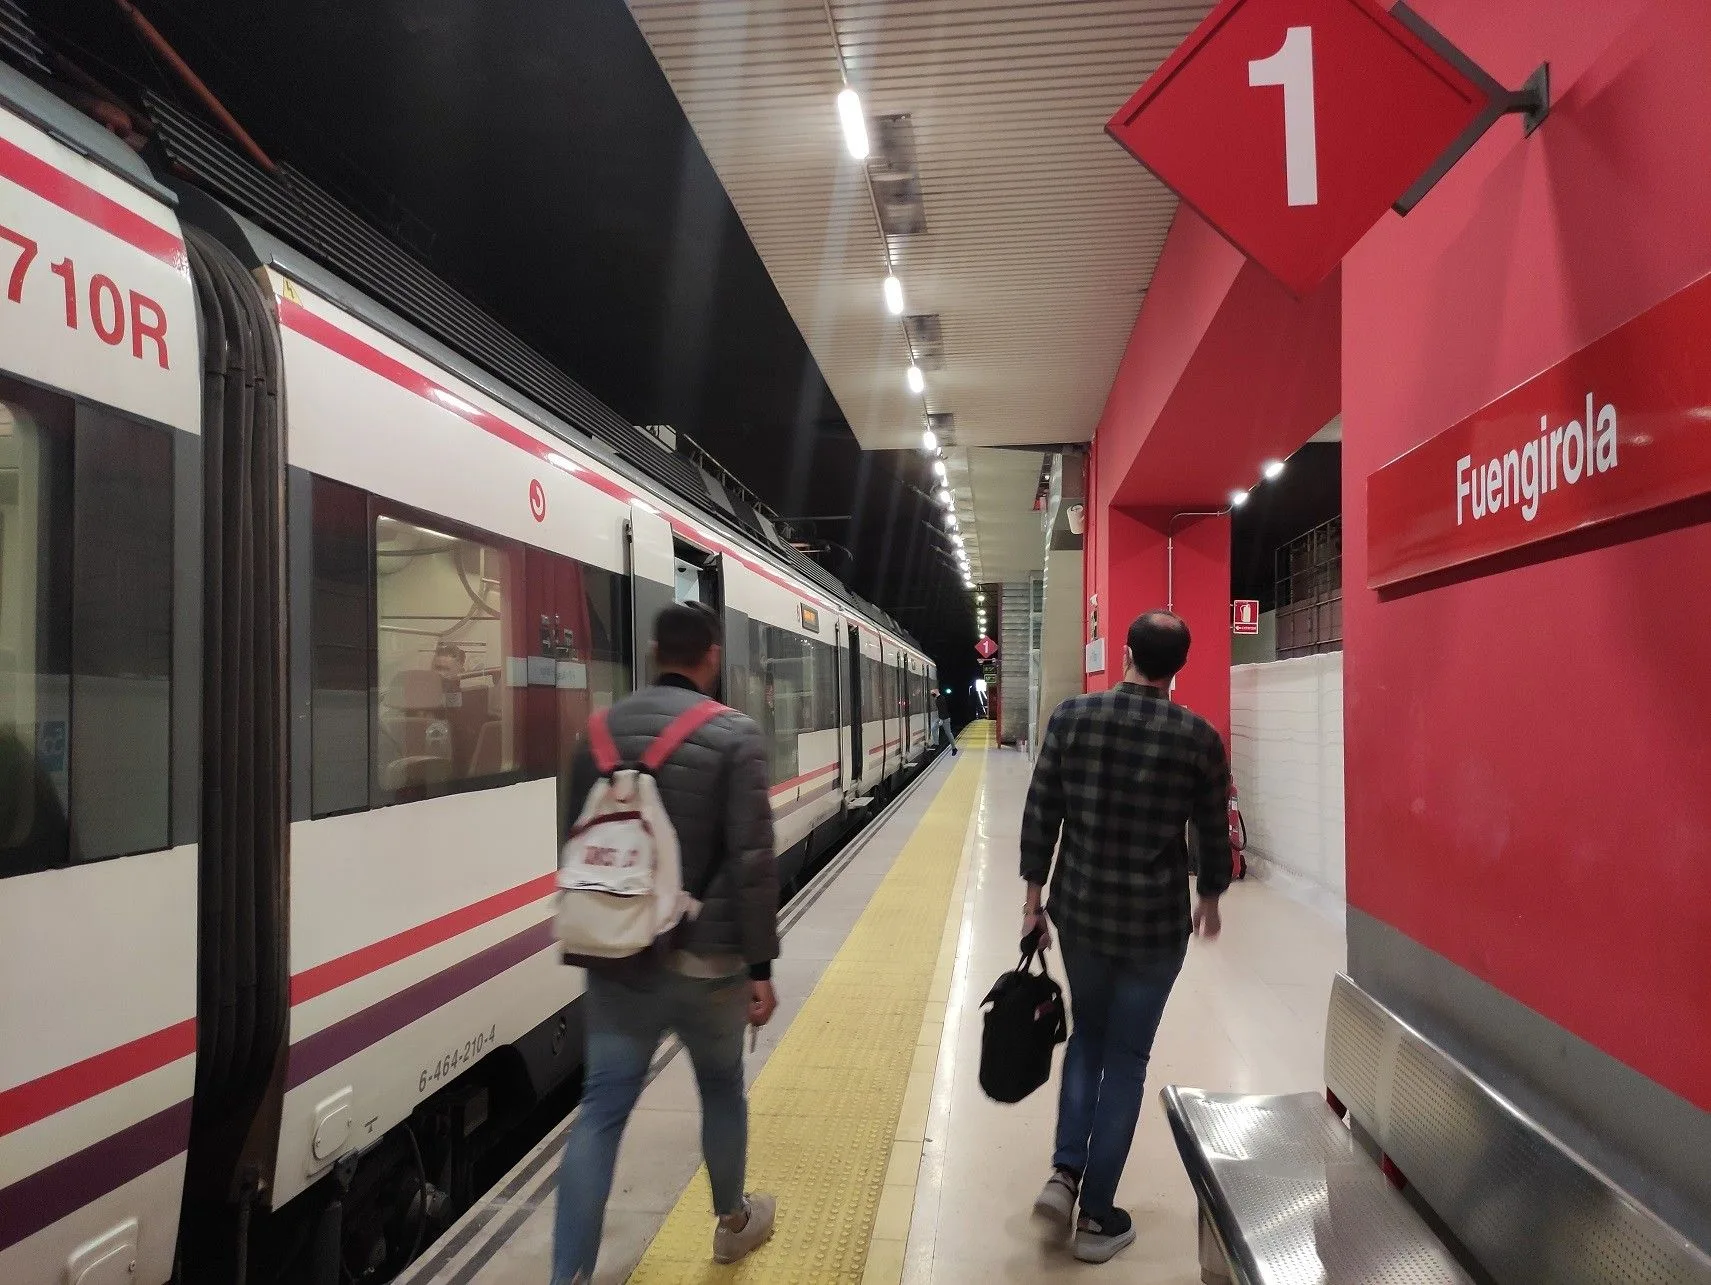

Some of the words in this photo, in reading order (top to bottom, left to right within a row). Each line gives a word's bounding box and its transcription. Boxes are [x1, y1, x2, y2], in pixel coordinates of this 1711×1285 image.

[1249, 26, 1318, 206] 1
[0, 225, 170, 370] 710R
[1456, 391, 1618, 526] Fuengirola
[983, 640, 989, 654] 1
[419, 1024, 496, 1092] 6-464-210-4
